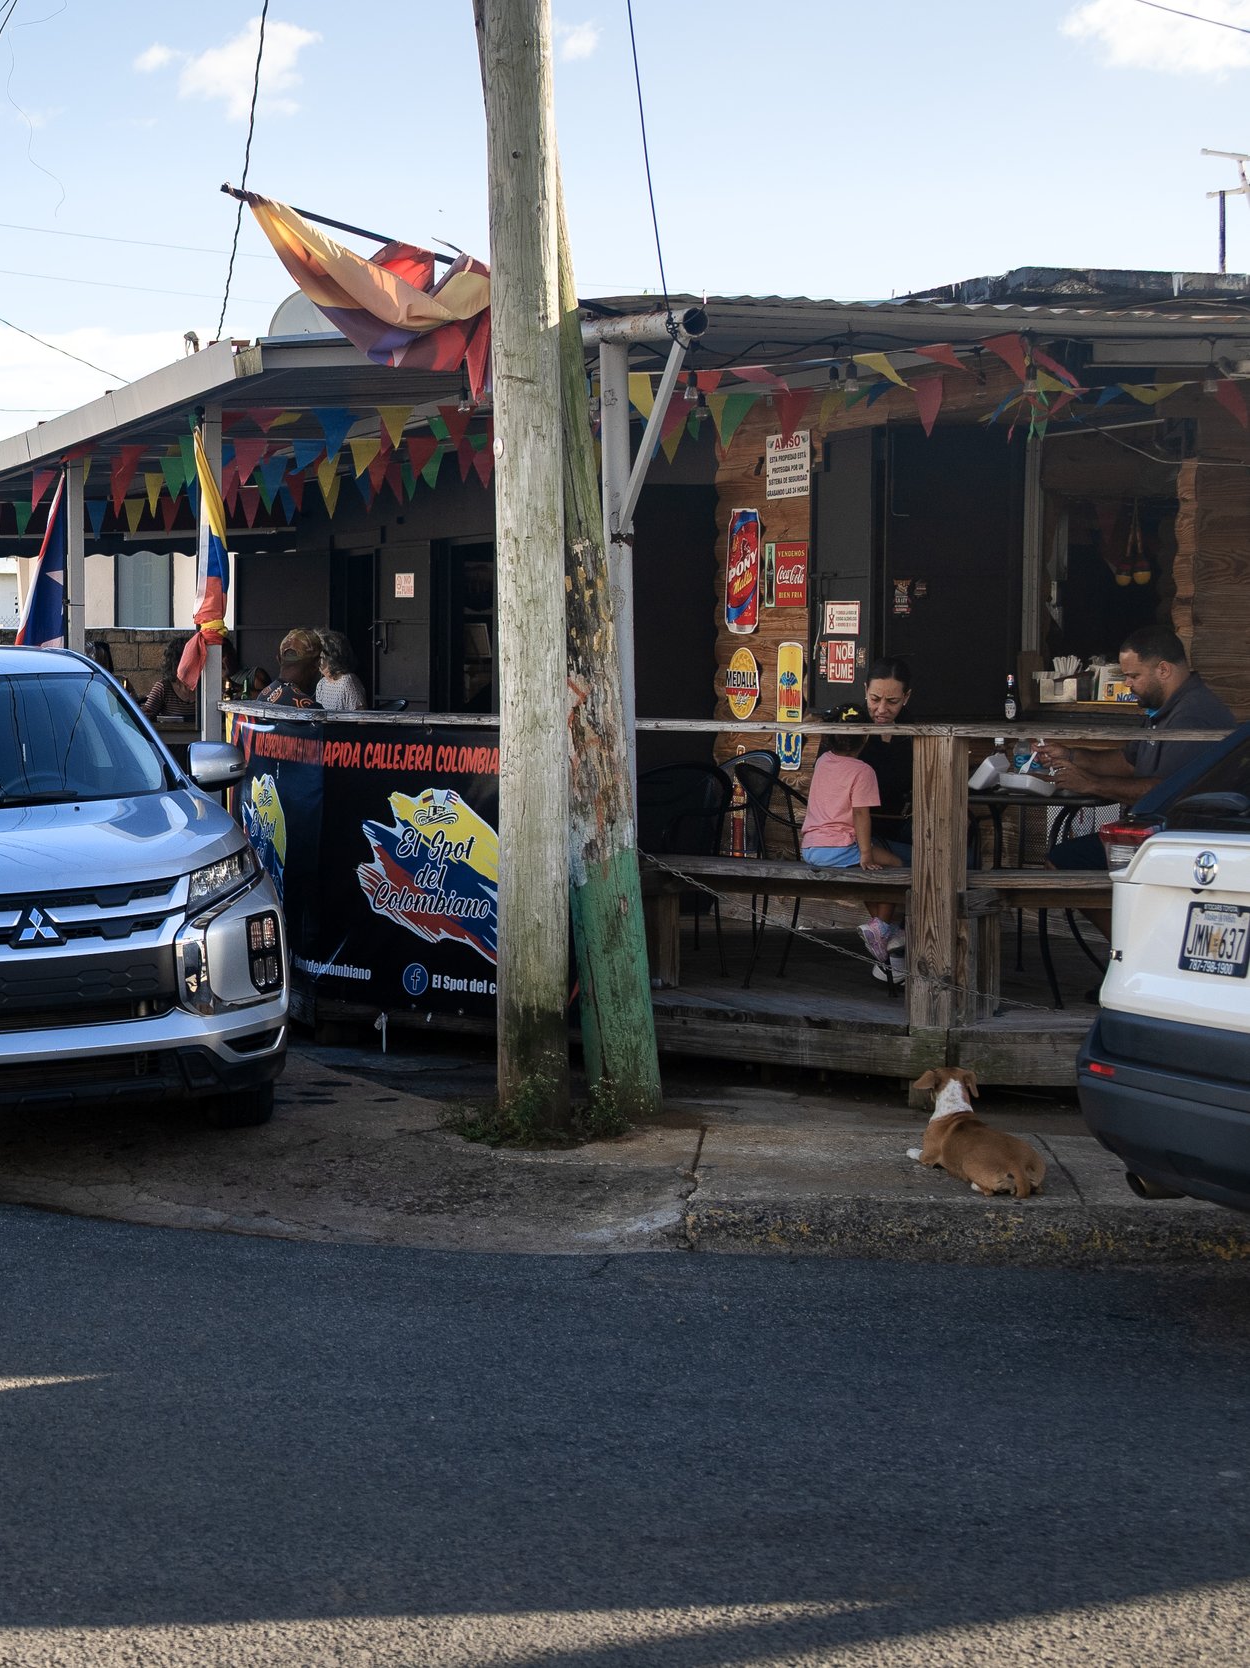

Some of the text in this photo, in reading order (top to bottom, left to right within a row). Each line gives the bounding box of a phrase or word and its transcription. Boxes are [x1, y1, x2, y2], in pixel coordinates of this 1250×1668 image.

[728, 548, 758, 583] PONY
[778, 591, 791, 599] BIEN
[835, 644, 848, 661] NO
[726, 669, 757, 688] MEDALLA
[829, 662, 853, 679] FUME
[364, 742, 433, 772] CALLEJERA
[435, 745, 500, 775] COLOMBIA
[396, 826, 476, 866] El Spot
[414, 863, 447, 890] del
[373, 881, 490, 919] Colombiano
[1187, 924, 1246, 961] JMN 637
[1188, 959, 1234, 975] 787-798-1900
[432, 974, 442, 988] El
[443, 975, 468, 993] Spot
[469, 979, 487, 994] del
